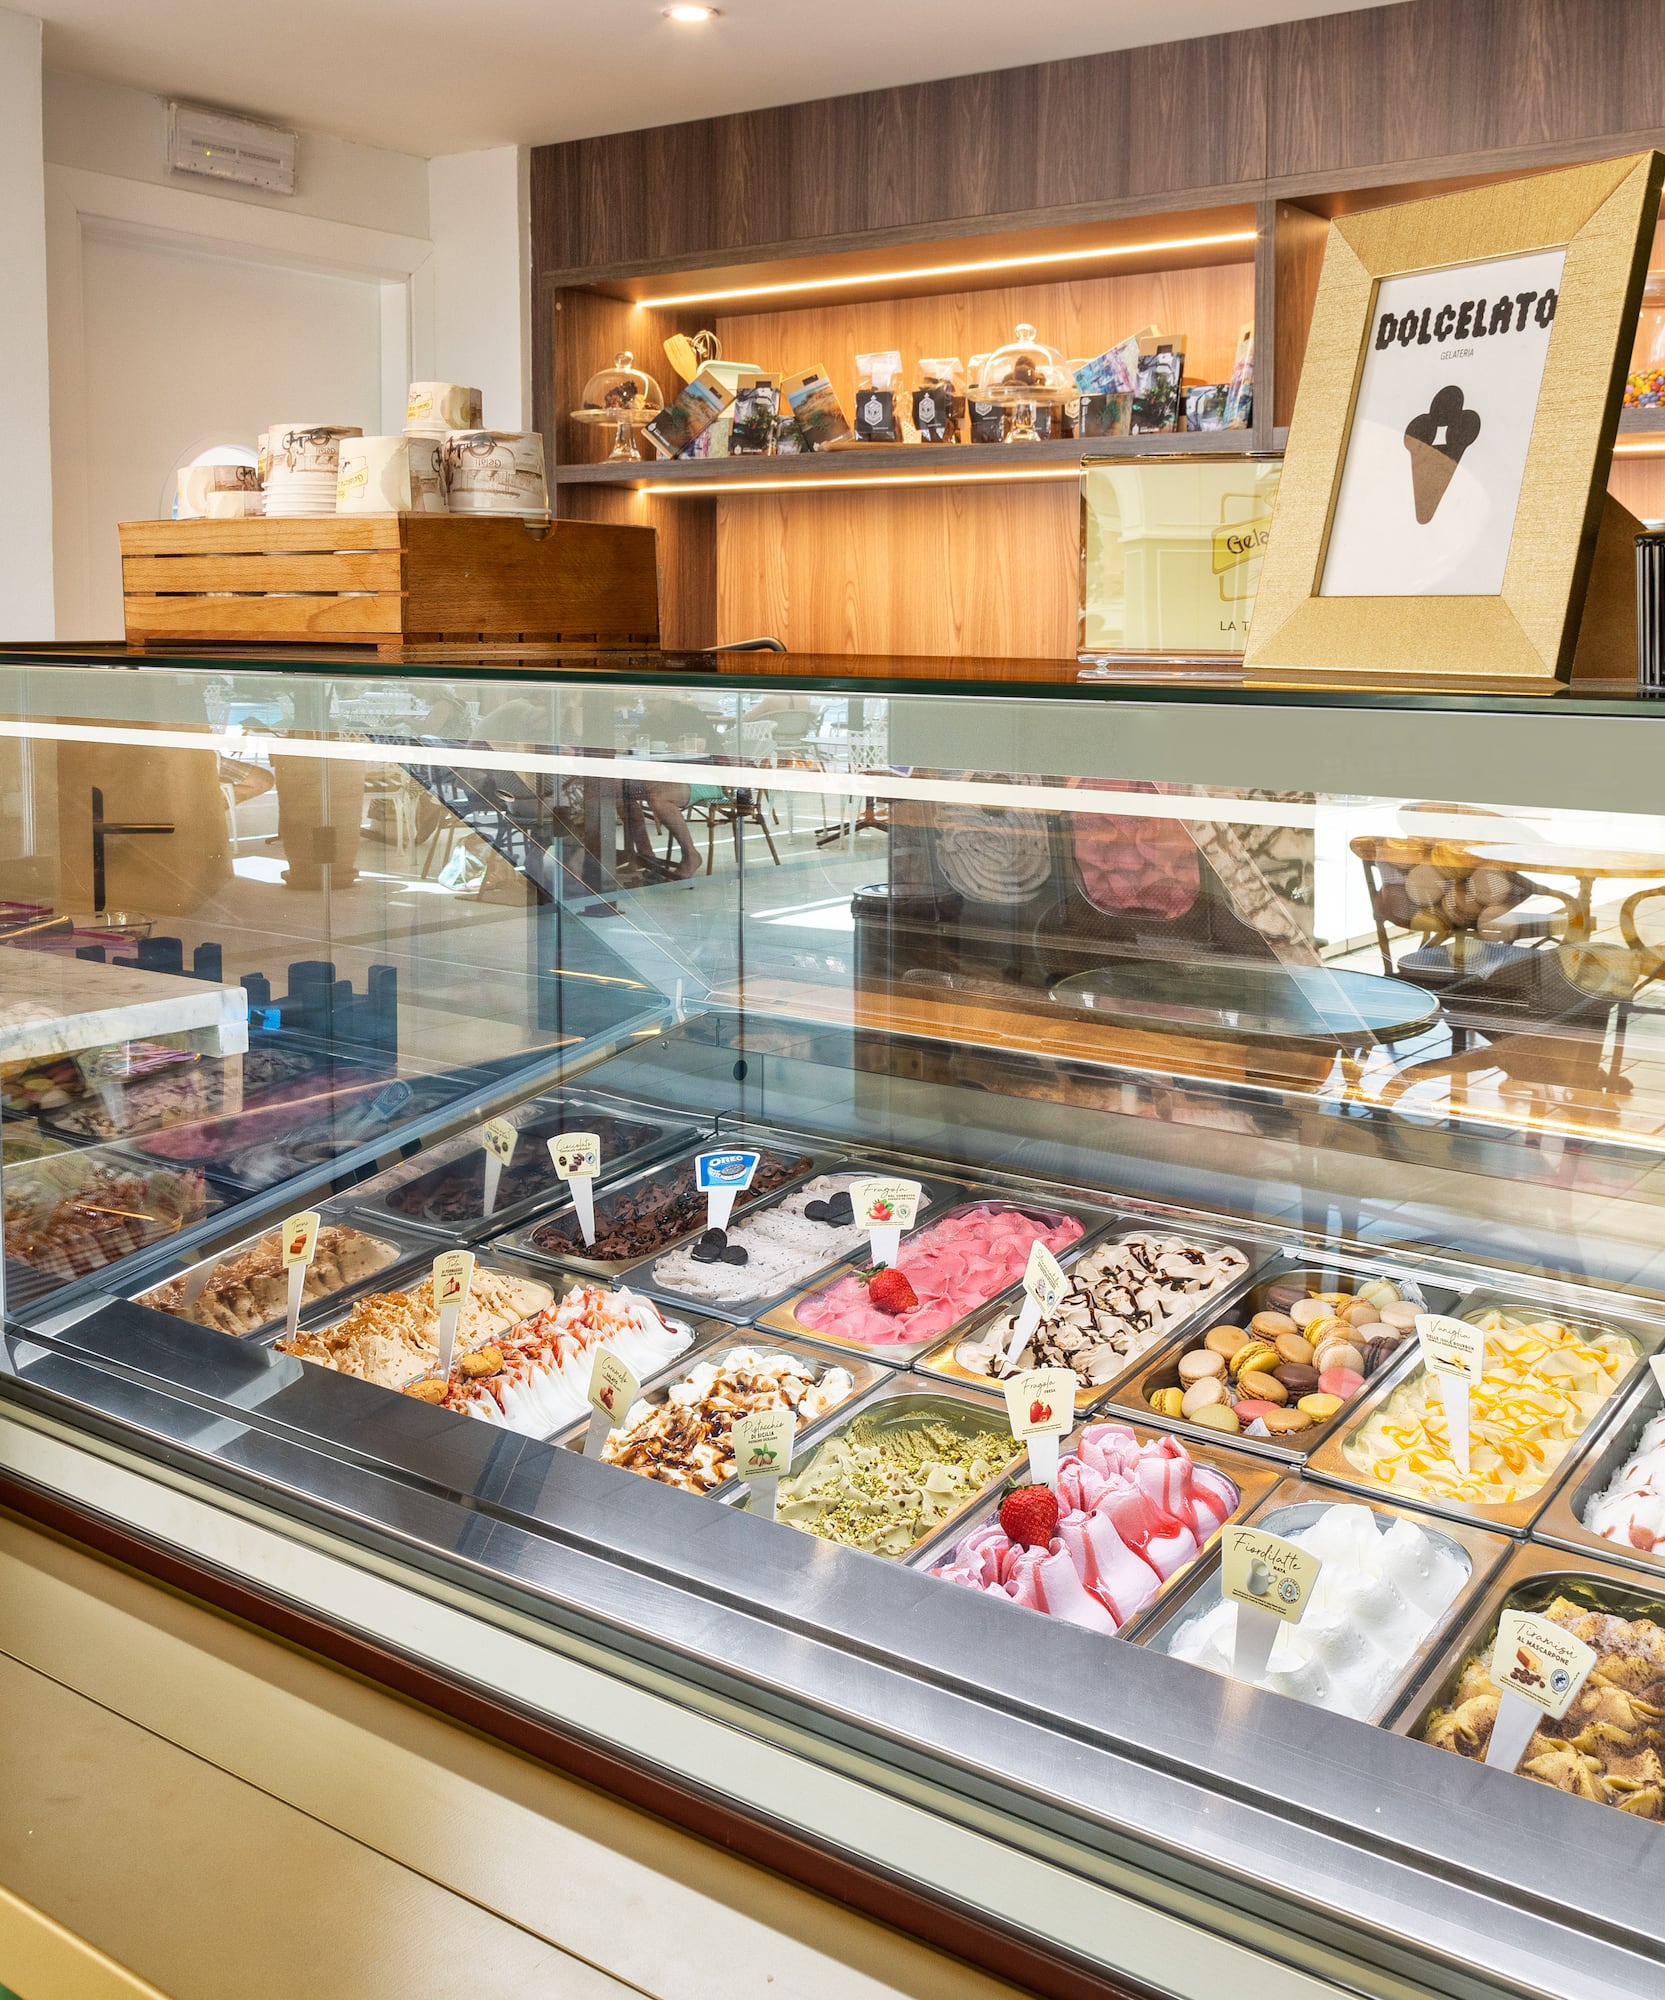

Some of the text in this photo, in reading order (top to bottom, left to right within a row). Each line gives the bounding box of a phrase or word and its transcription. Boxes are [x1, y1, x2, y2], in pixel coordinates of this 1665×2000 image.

[1375, 289, 1559, 350] DOLCELATO
[1440, 348, 1475, 360] GELATERIA
[1220, 621, 1237, 631] LA
[709, 1155, 744, 1167] OREO
[862, 1183, 909, 1198] Fragola
[1430, 1320, 1471, 1342] Vaniglia
[1021, 1375, 1056, 1397] Fragola
[742, 1416, 784, 1438] Pistacchio
[1234, 1532, 1301, 1570] Fiordilatte
[1273, 1565, 1286, 1574] NATA
[1513, 1620, 1578, 1659] Tiramisù
[1516, 1635, 1571, 1666] AL MASCARPONE
